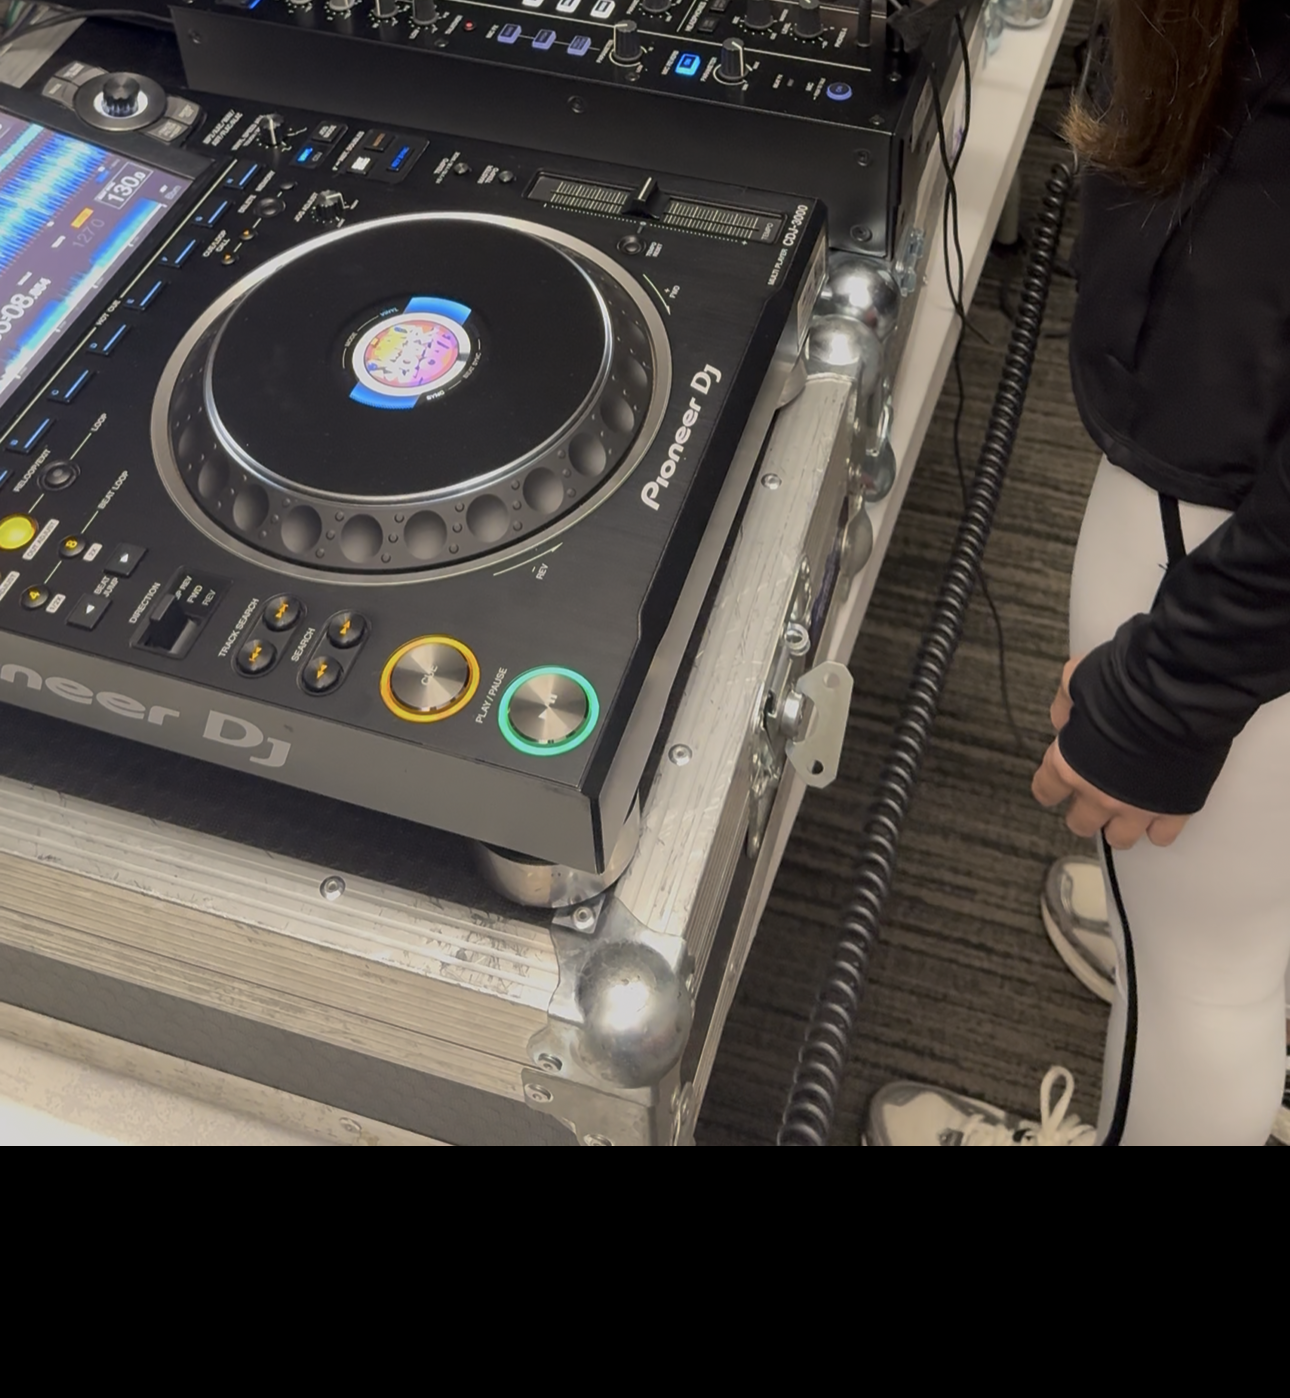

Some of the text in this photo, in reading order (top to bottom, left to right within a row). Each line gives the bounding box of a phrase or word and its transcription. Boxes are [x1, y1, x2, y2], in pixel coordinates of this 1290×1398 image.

[767, 266, 780, 286] MULTI
[782, 204, 809, 248] CDJ-3000
[96, 312, 110, 326] HOT
[91, 412, 107, 433] LOOP
[640, 363, 722, 511] Pioneer Dj
[13, 449, 51, 492] RELOOP/EXIT
[98, 470, 129, 510] BEAT LOOP
[65, 538, 78, 550] 8
[535, 562, 549, 581] REV
[94, 575, 110, 595] BEAT
[103, 577, 119, 598] JUMP
[181, 575, 193, 592] REV
[187, 584, 203, 604] FWD
[29, 590, 40, 600] 4
[129, 582, 162, 624] DIRECTION
[201, 589, 216, 607] REV
[217, 597, 260, 658] TRACK SEARCH
[291, 627, 316, 662] SEARCH
[421, 663, 438, 687] CUE
[203, 709, 292, 768] Dj
